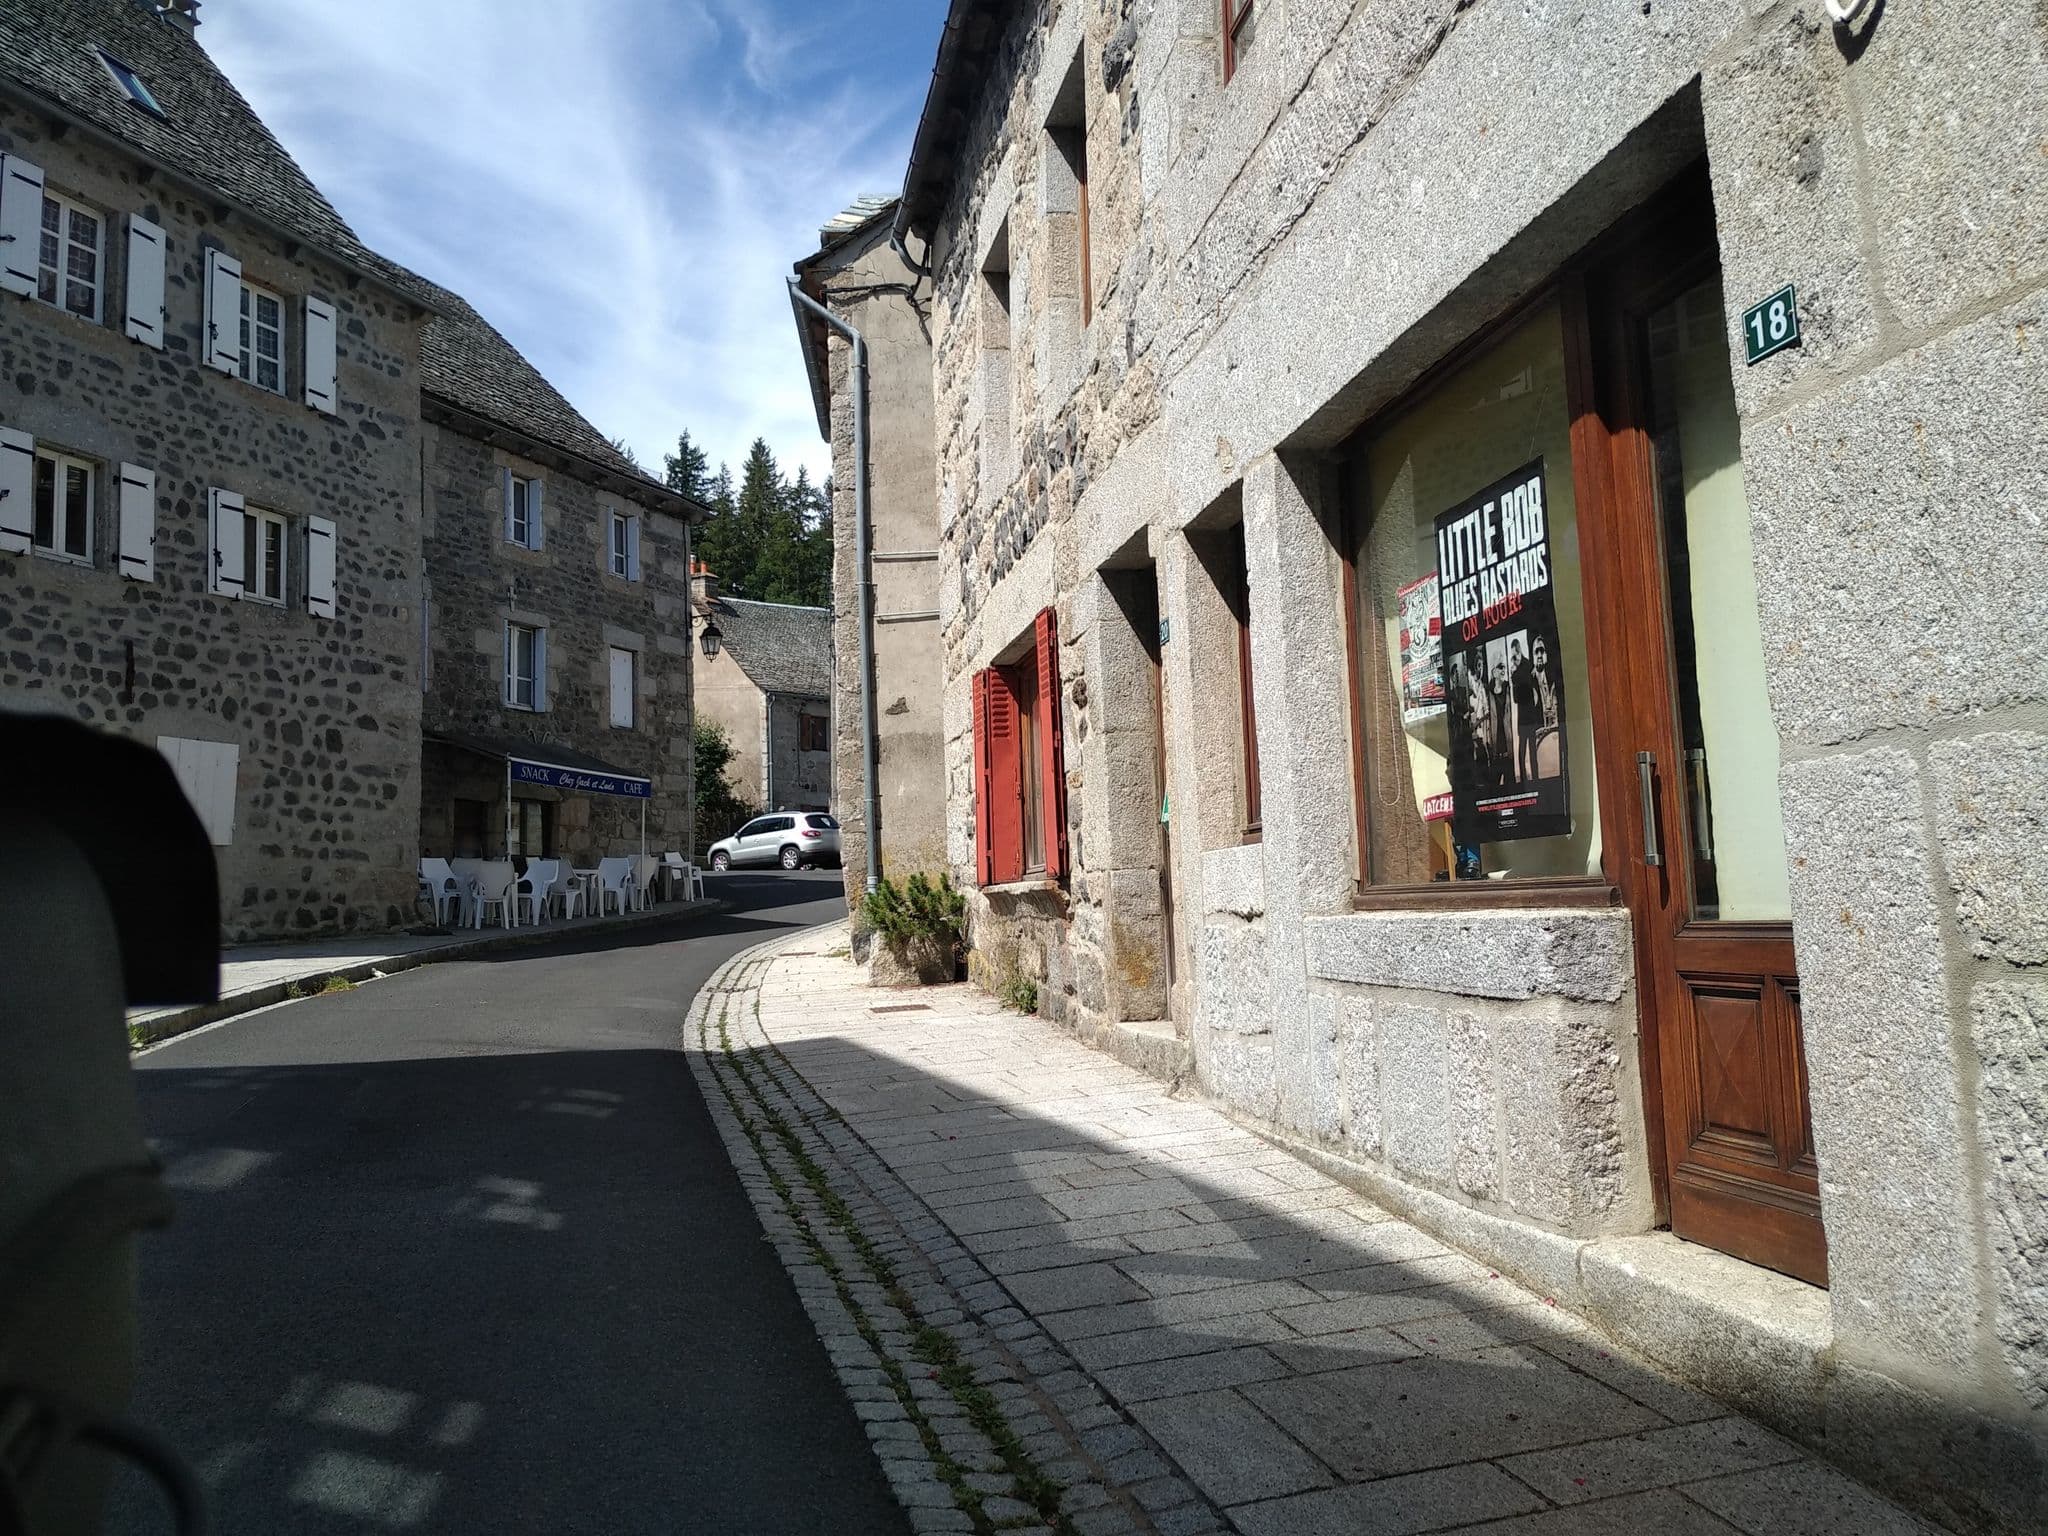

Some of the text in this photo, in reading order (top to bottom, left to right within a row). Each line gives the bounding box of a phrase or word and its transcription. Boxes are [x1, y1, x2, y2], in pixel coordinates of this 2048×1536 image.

[1750, 300, 1788, 349] 18
[1438, 476, 1544, 588] LITTLE BOB
[1442, 574, 1479, 627] BLUES
[1480, 543, 1548, 609] BASTARDS
[1462, 616, 1479, 642] ON
[1483, 589, 1522, 630] TOUR!
[520, 766, 550, 782] SNACK
[559, 772, 575, 788] Chez
[575, 775, 591, 790] Jack
[623, 781, 643, 795] CAFE
